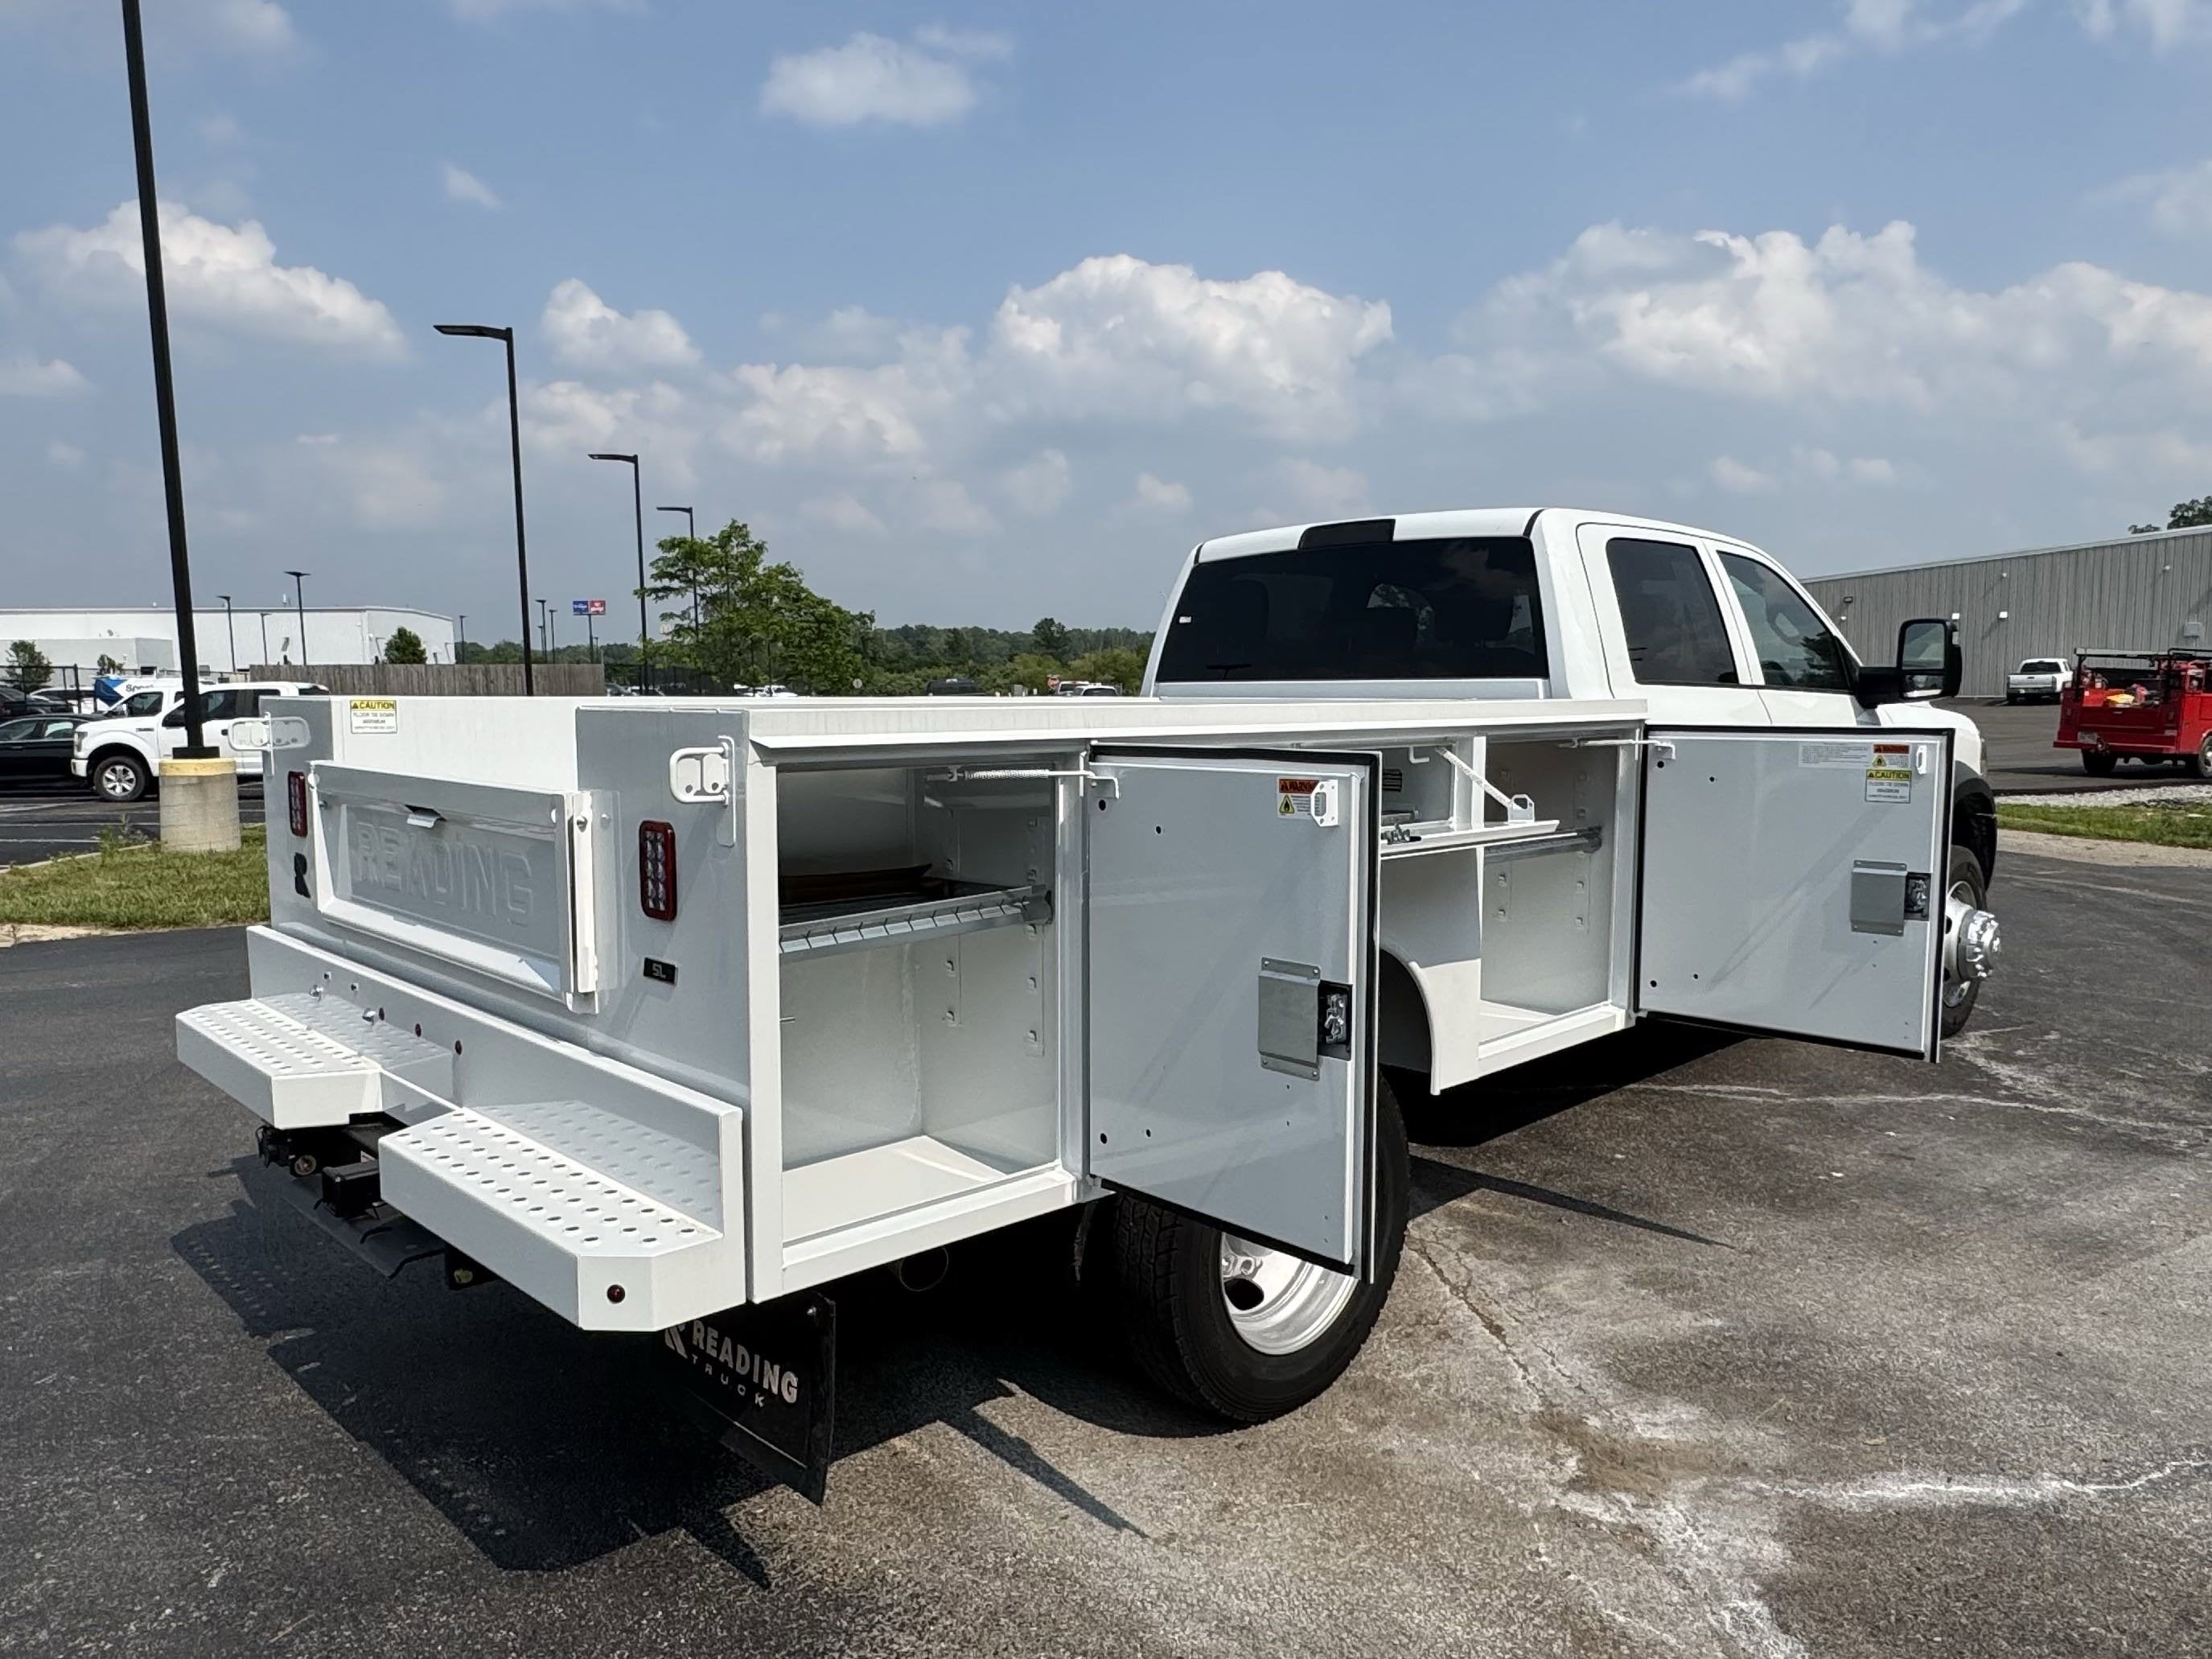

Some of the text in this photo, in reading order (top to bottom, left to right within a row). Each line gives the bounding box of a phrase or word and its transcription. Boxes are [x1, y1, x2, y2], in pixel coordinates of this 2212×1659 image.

[360, 702, 395, 710] CAUTION
[1875, 771, 1910, 780] CAUTION
[352, 820, 533, 928] READING
[691, 1353, 765, 1408] TRUCK
[692, 1319, 799, 1404] READING
